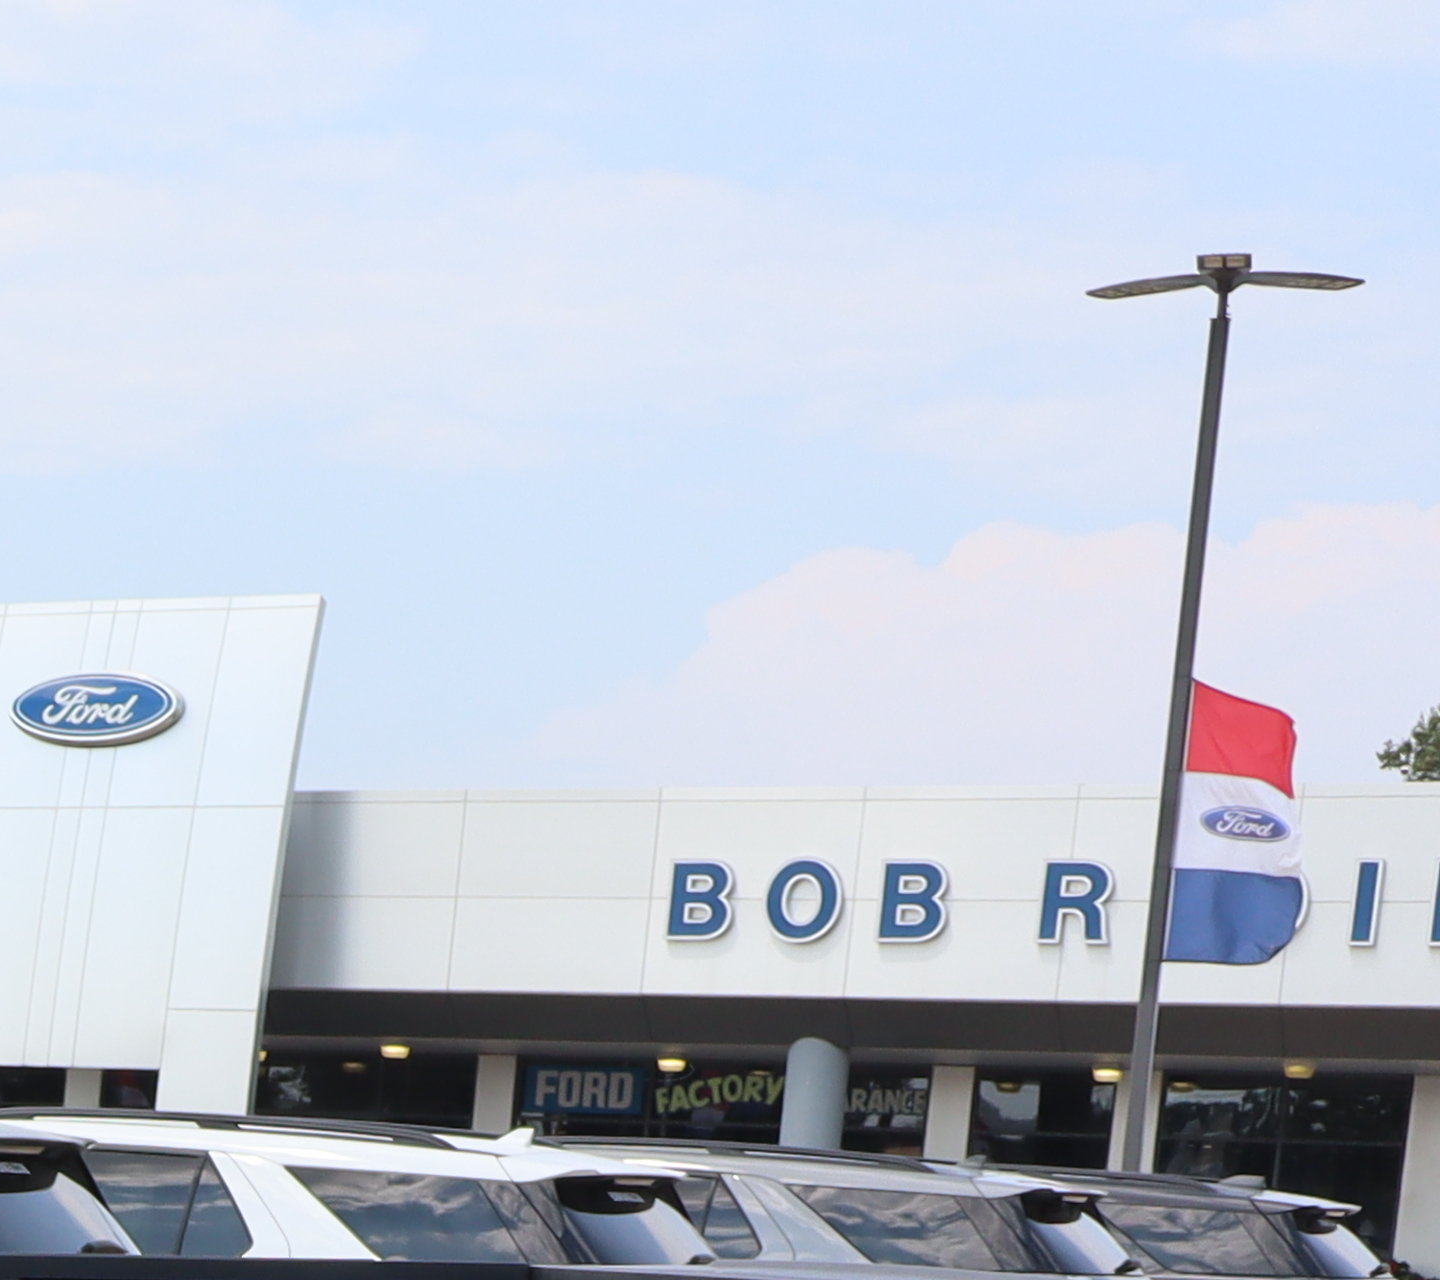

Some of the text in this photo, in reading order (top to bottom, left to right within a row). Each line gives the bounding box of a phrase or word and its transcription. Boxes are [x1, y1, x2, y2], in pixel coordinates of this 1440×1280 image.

[42, 685, 139, 725] Ford
[1216, 810, 1275, 837] Ford
[666, 857, 949, 945] BOB
[535, 1070, 928, 1115] FORD FACTORY RANCE
